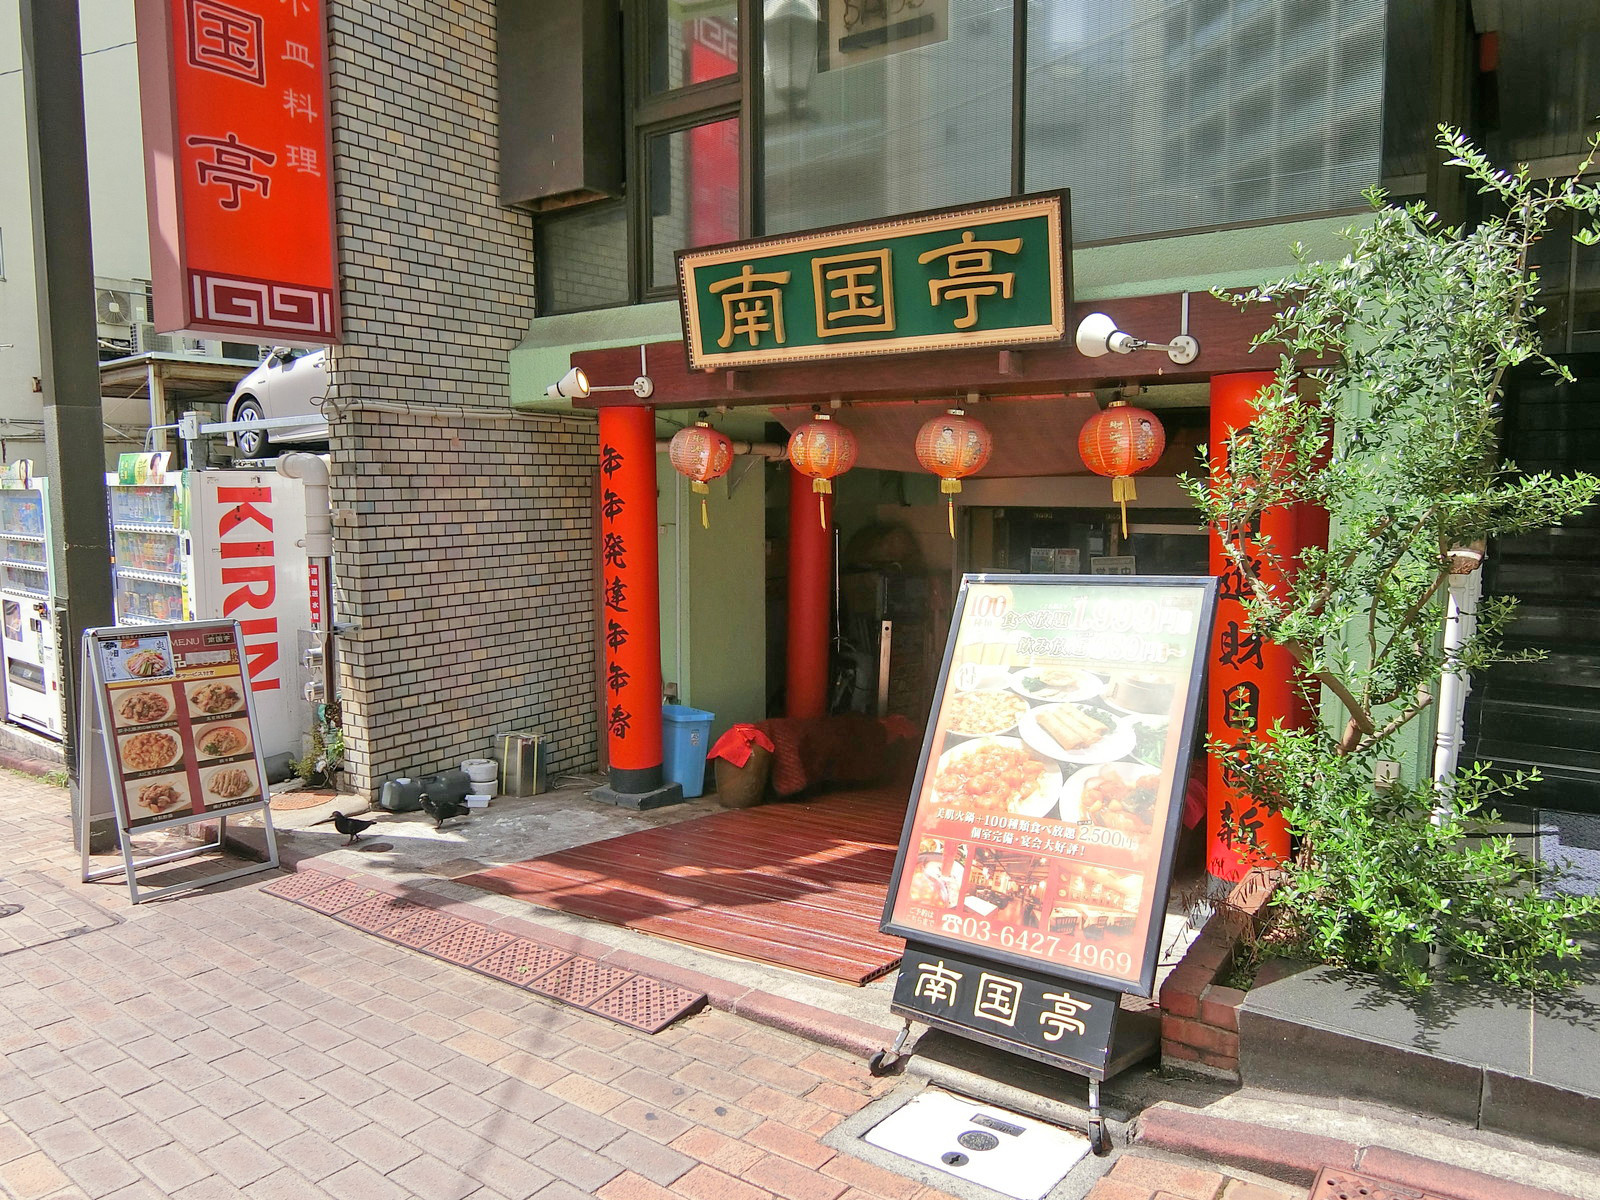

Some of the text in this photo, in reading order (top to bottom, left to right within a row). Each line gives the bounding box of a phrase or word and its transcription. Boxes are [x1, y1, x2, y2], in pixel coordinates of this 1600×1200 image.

[184, 0, 276, 211] 国亭
[708, 231, 1024, 348] 南国亭
[217, 486, 281, 691] KIRIN
[968, 595, 1007, 617] 100
[1001, 609, 1072, 629] 食べ放題
[171, 637, 200, 647] MENU
[962, 916, 1132, 975] 03-6427-4969
[914, 961, 1093, 1041] 南国亭
